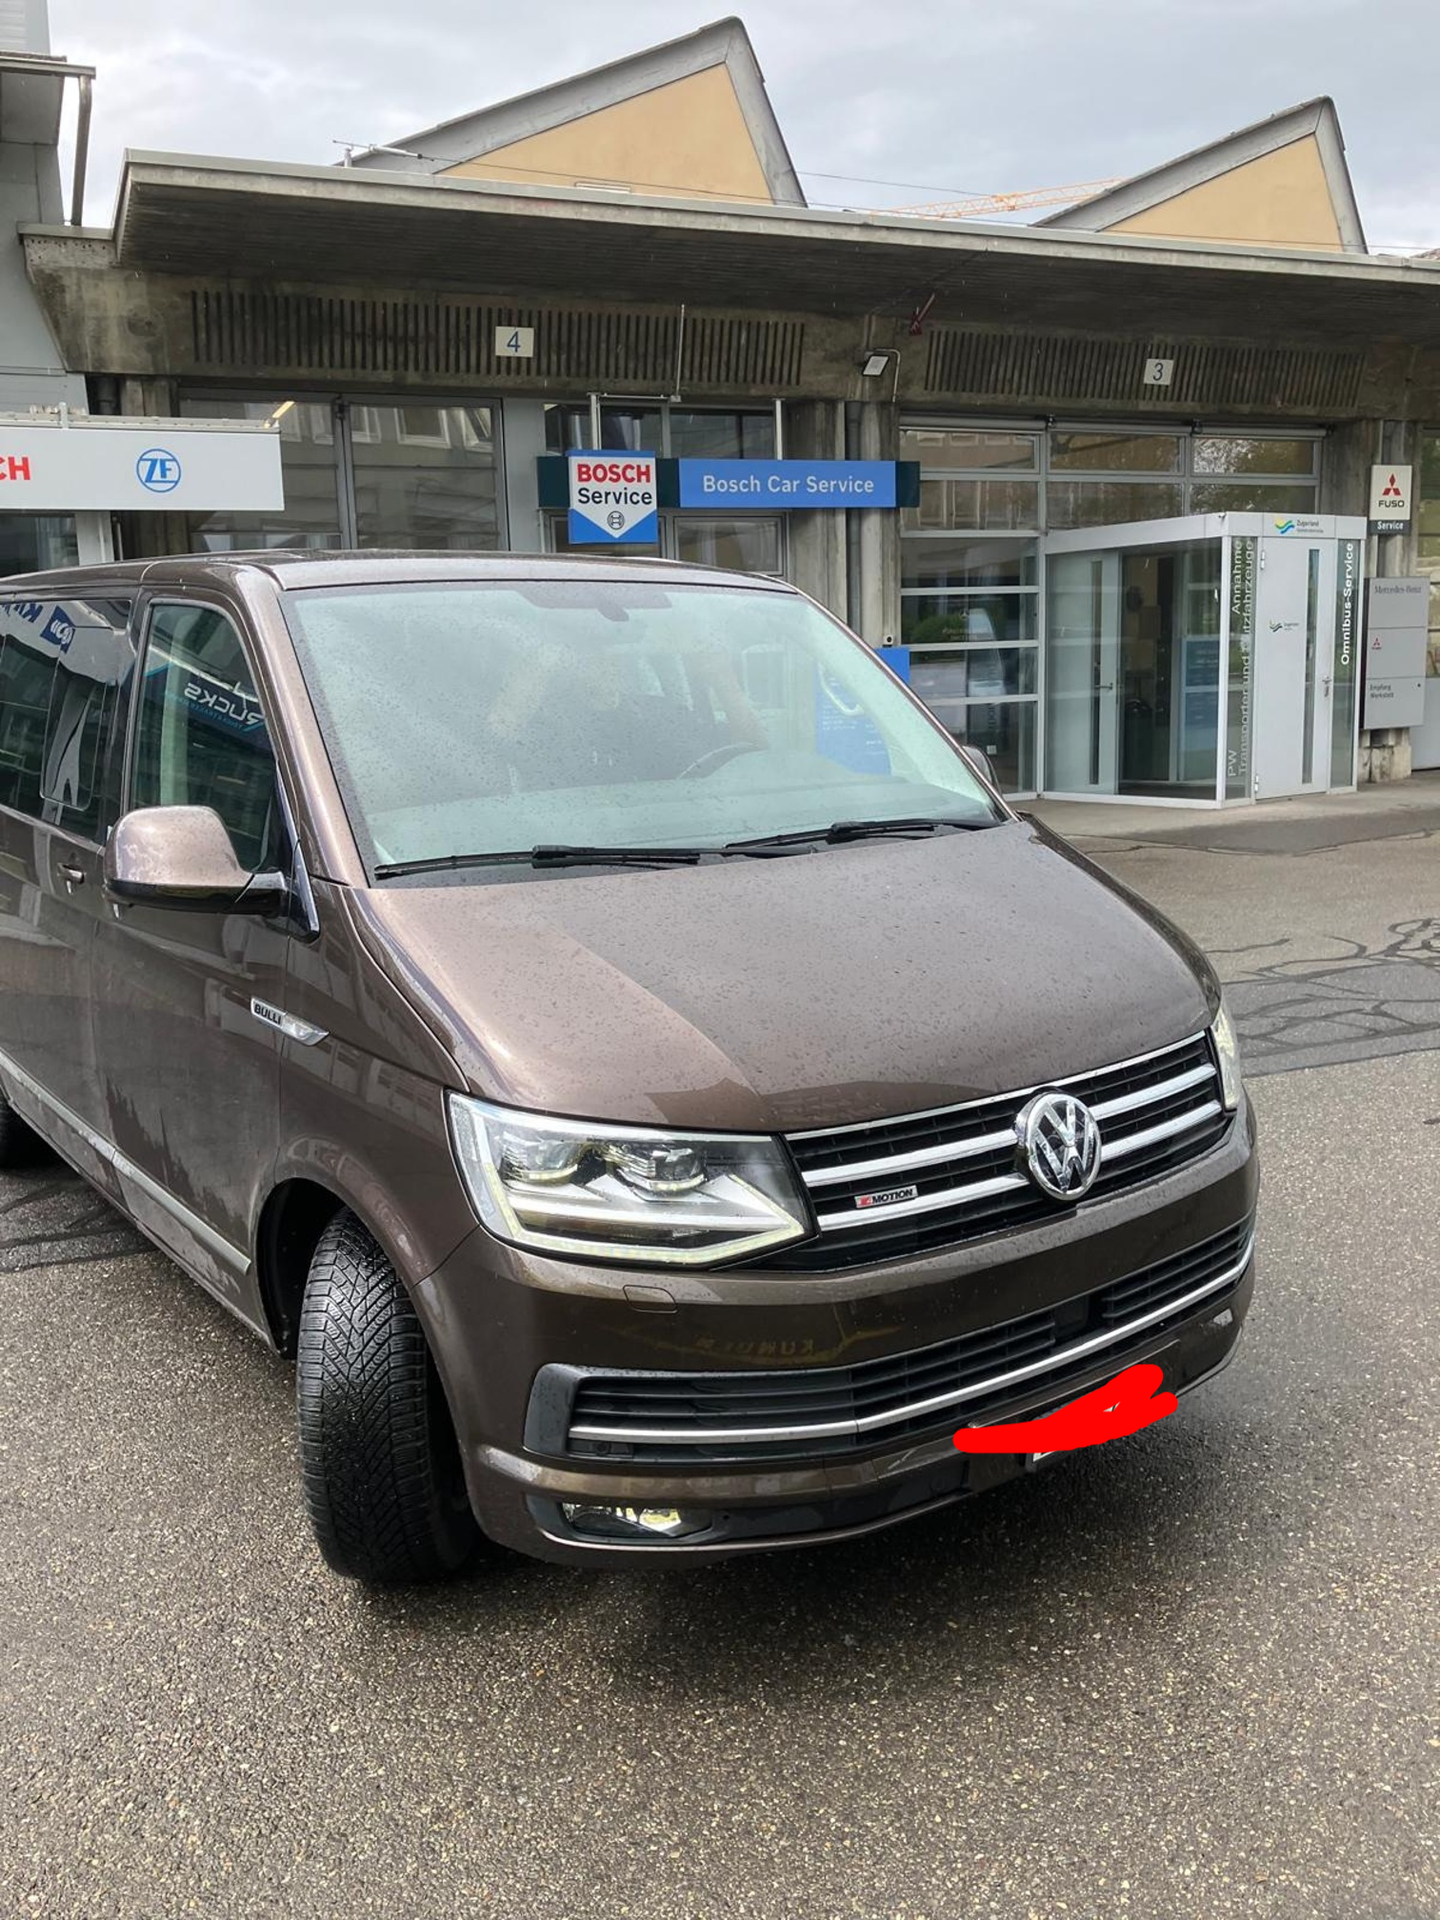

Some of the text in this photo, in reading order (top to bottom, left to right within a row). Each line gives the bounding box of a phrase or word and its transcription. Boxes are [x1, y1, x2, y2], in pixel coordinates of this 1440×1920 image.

[507, 331, 521, 353] 4
[1153, 362, 1164, 381] 3
[138, 456, 179, 485] ZF
[577, 464, 651, 483] BOSCH
[703, 475, 874, 493] Bosch Car Service
[577, 487, 653, 506] Service
[1378, 500, 1405, 508] FUSO
[1377, 521, 1404, 531] Service
[1231, 540, 1242, 615] Annahme
[1341, 543, 1354, 665] Omnibus-Service
[1241, 655, 1251, 681] und
[1227, 750, 1238, 777] PW
[254, 1004, 282, 1025] BULLI
